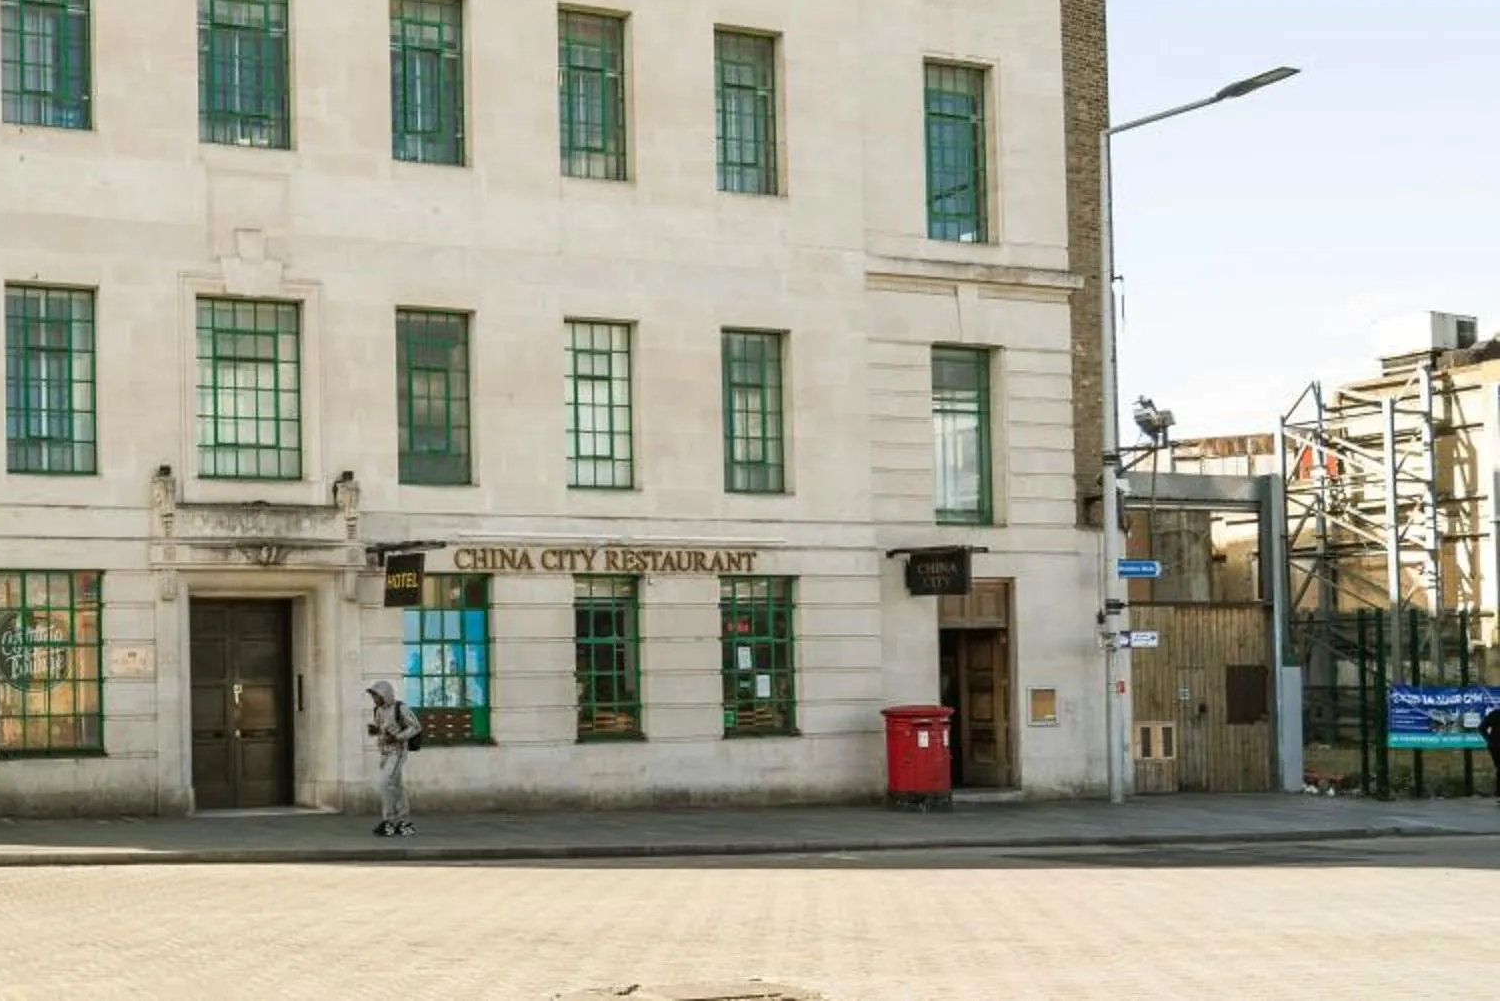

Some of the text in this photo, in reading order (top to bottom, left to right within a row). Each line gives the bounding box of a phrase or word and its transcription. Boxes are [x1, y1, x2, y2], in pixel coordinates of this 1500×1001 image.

[453, 548, 757, 573] CHINA CITY RESTAURANT
[387, 572, 419, 590] HOTEL
